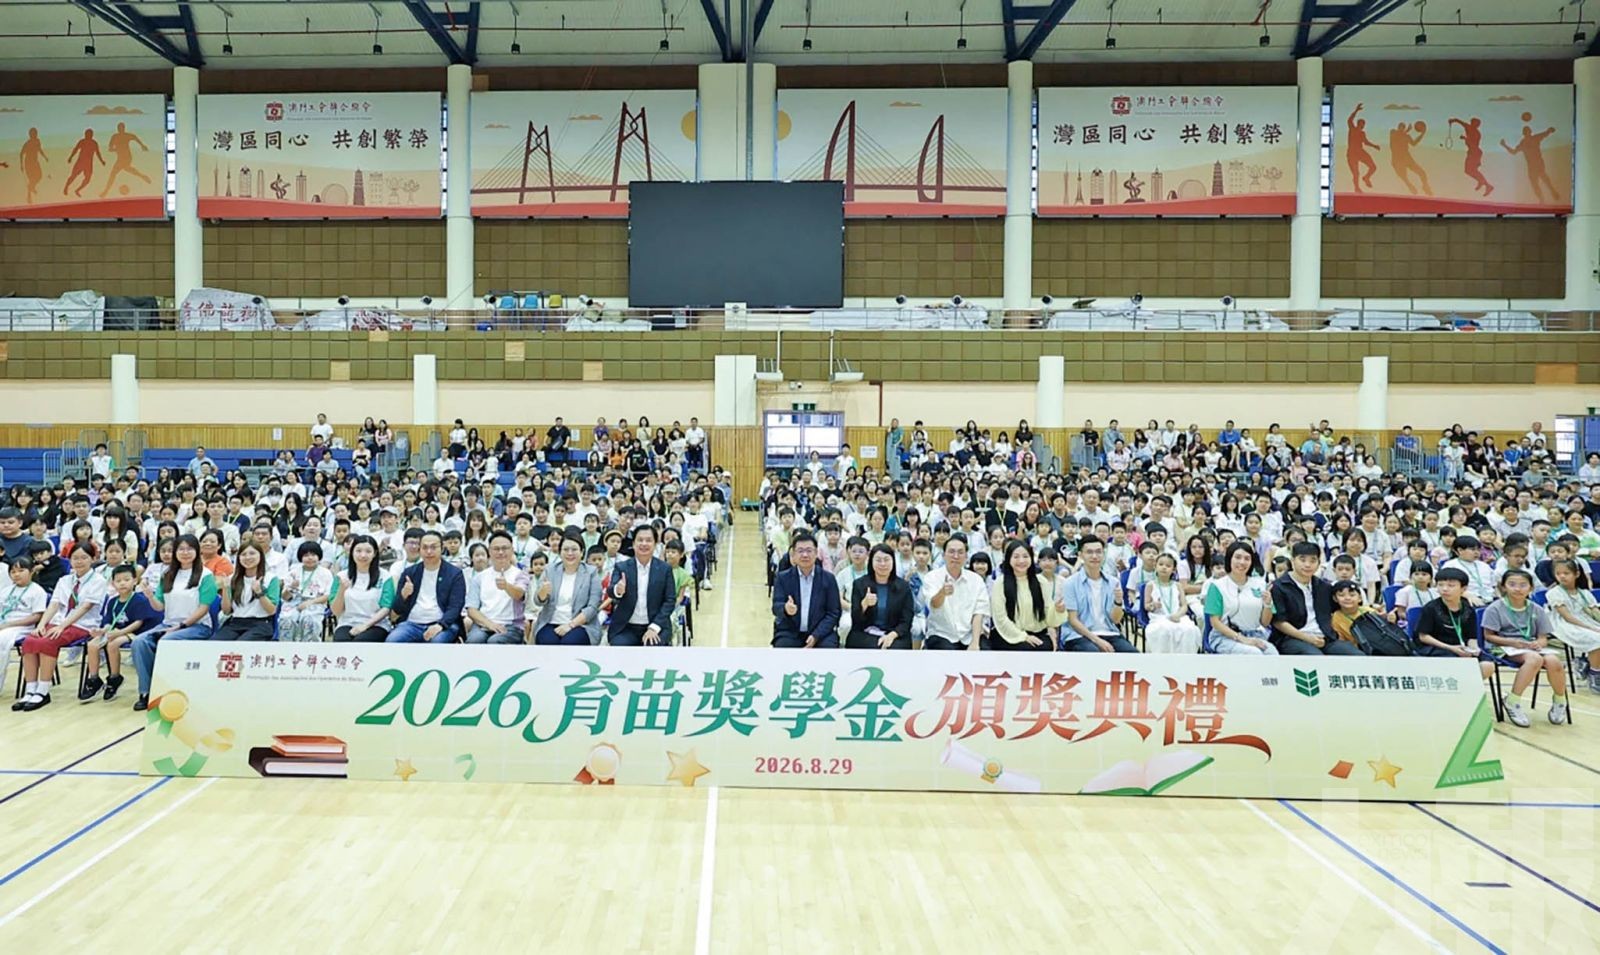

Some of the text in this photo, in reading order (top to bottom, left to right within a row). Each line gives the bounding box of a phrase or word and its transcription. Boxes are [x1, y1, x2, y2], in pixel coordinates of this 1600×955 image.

[213, 128, 429, 152] 灣區同心 共創繁榮
[1053, 122, 1283, 145] 灣區同心 共創繁榮
[354, 658, 1272, 762] 2026 育苗獎學金 頒獎典禮
[755, 757, 852, 775] 2026.8.29
